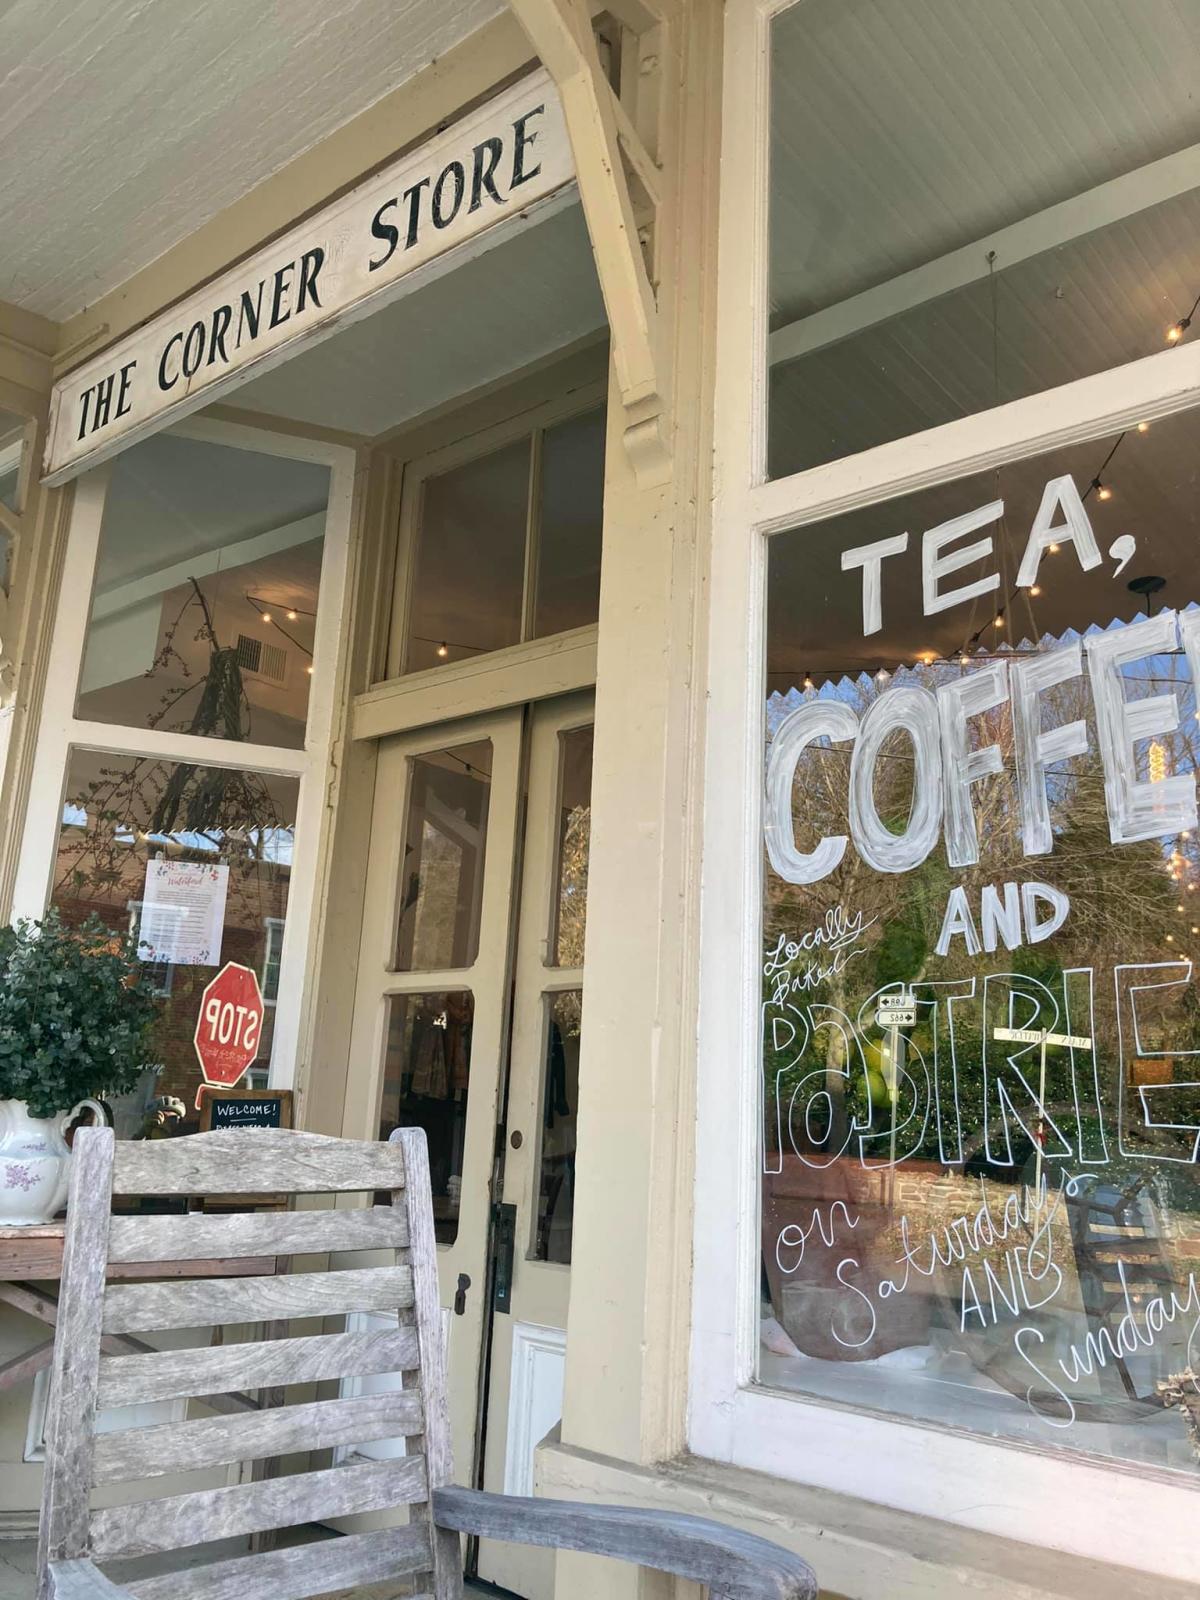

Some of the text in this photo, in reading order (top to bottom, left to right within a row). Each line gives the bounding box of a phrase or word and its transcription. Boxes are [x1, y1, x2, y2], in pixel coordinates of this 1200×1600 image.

[76, 103, 546, 441] THE CORNER STORE
[841, 473, 1137, 636] TEA,
[763, 905, 879, 976] Locally
[934, 881, 1070, 957] AND
[770, 948, 868, 1011] Baked
[217, 1103, 276, 1116] WELCOME!
[960, 1246, 1063, 1332] AND
